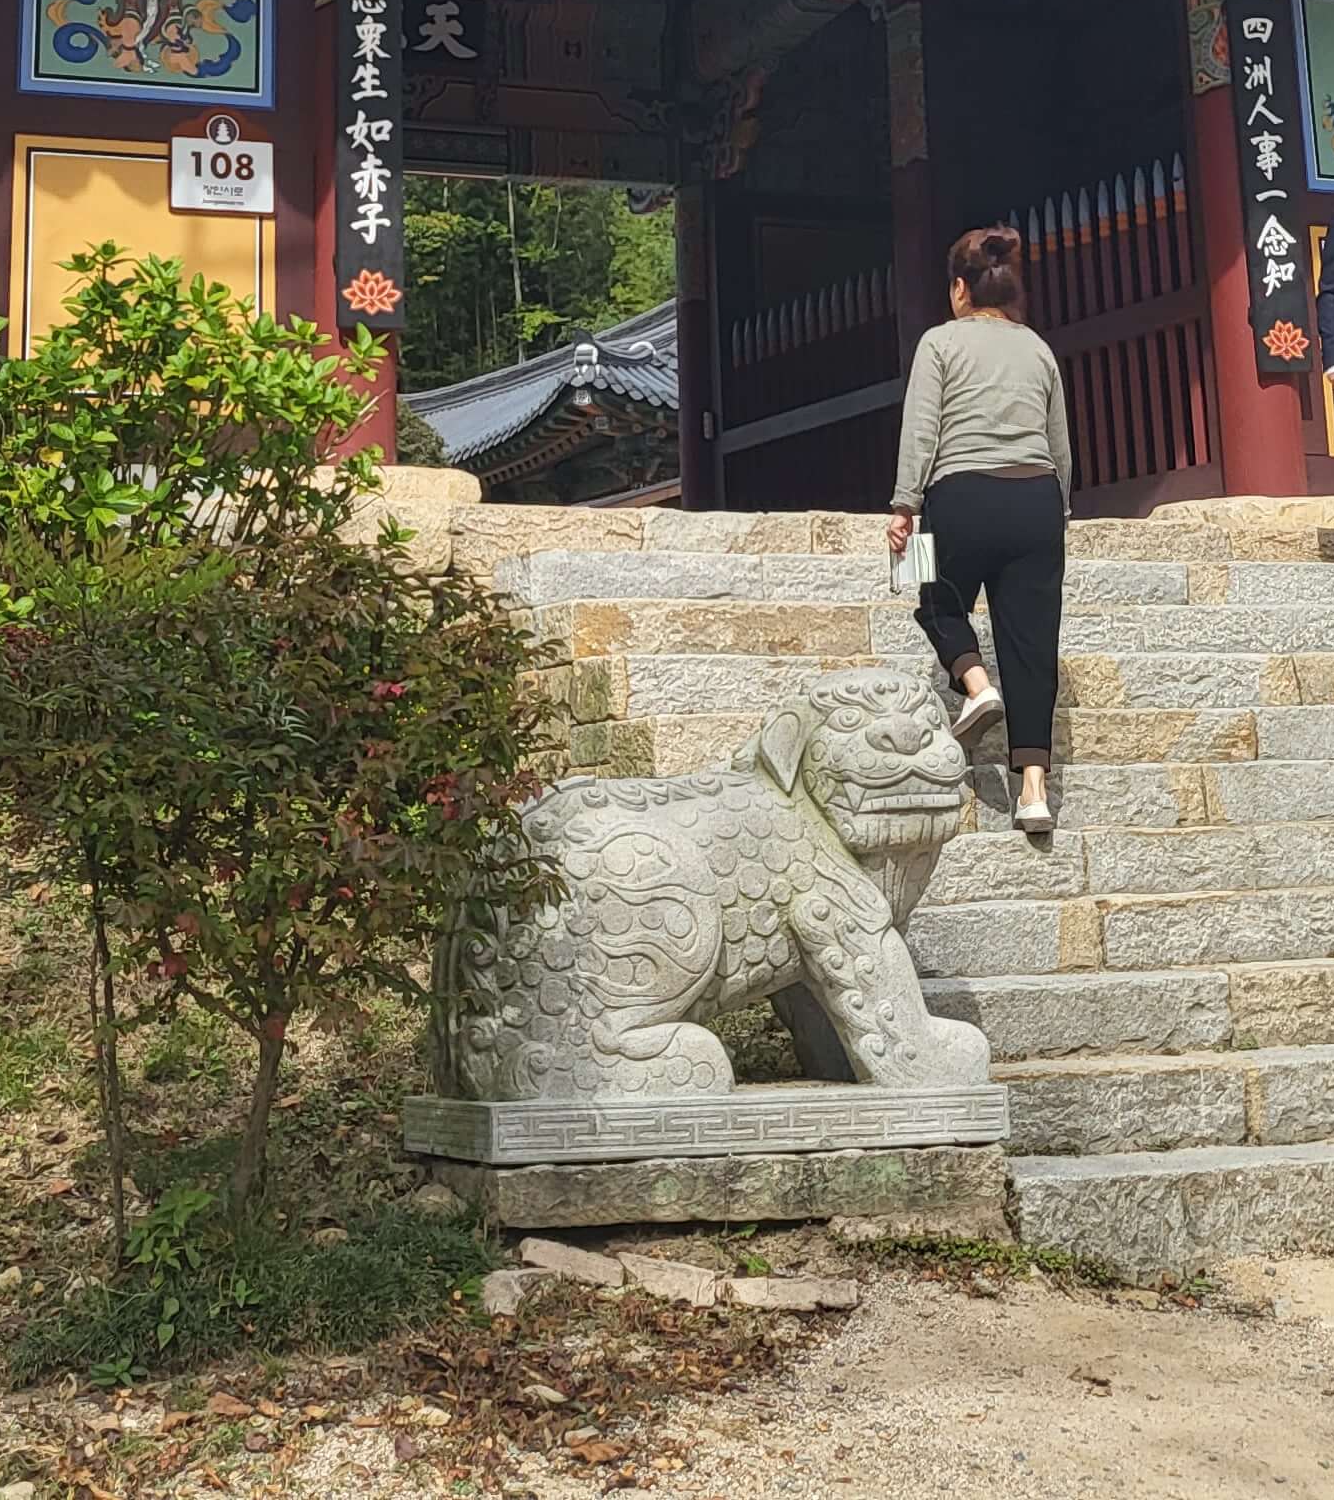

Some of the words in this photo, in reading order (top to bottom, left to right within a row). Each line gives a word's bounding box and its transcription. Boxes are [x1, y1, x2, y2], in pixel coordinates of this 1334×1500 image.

[401, 1, 479, 59] 天
[190, 150, 255, 181] 108
[1242, 17, 1298, 298] 四洲人事一念知
